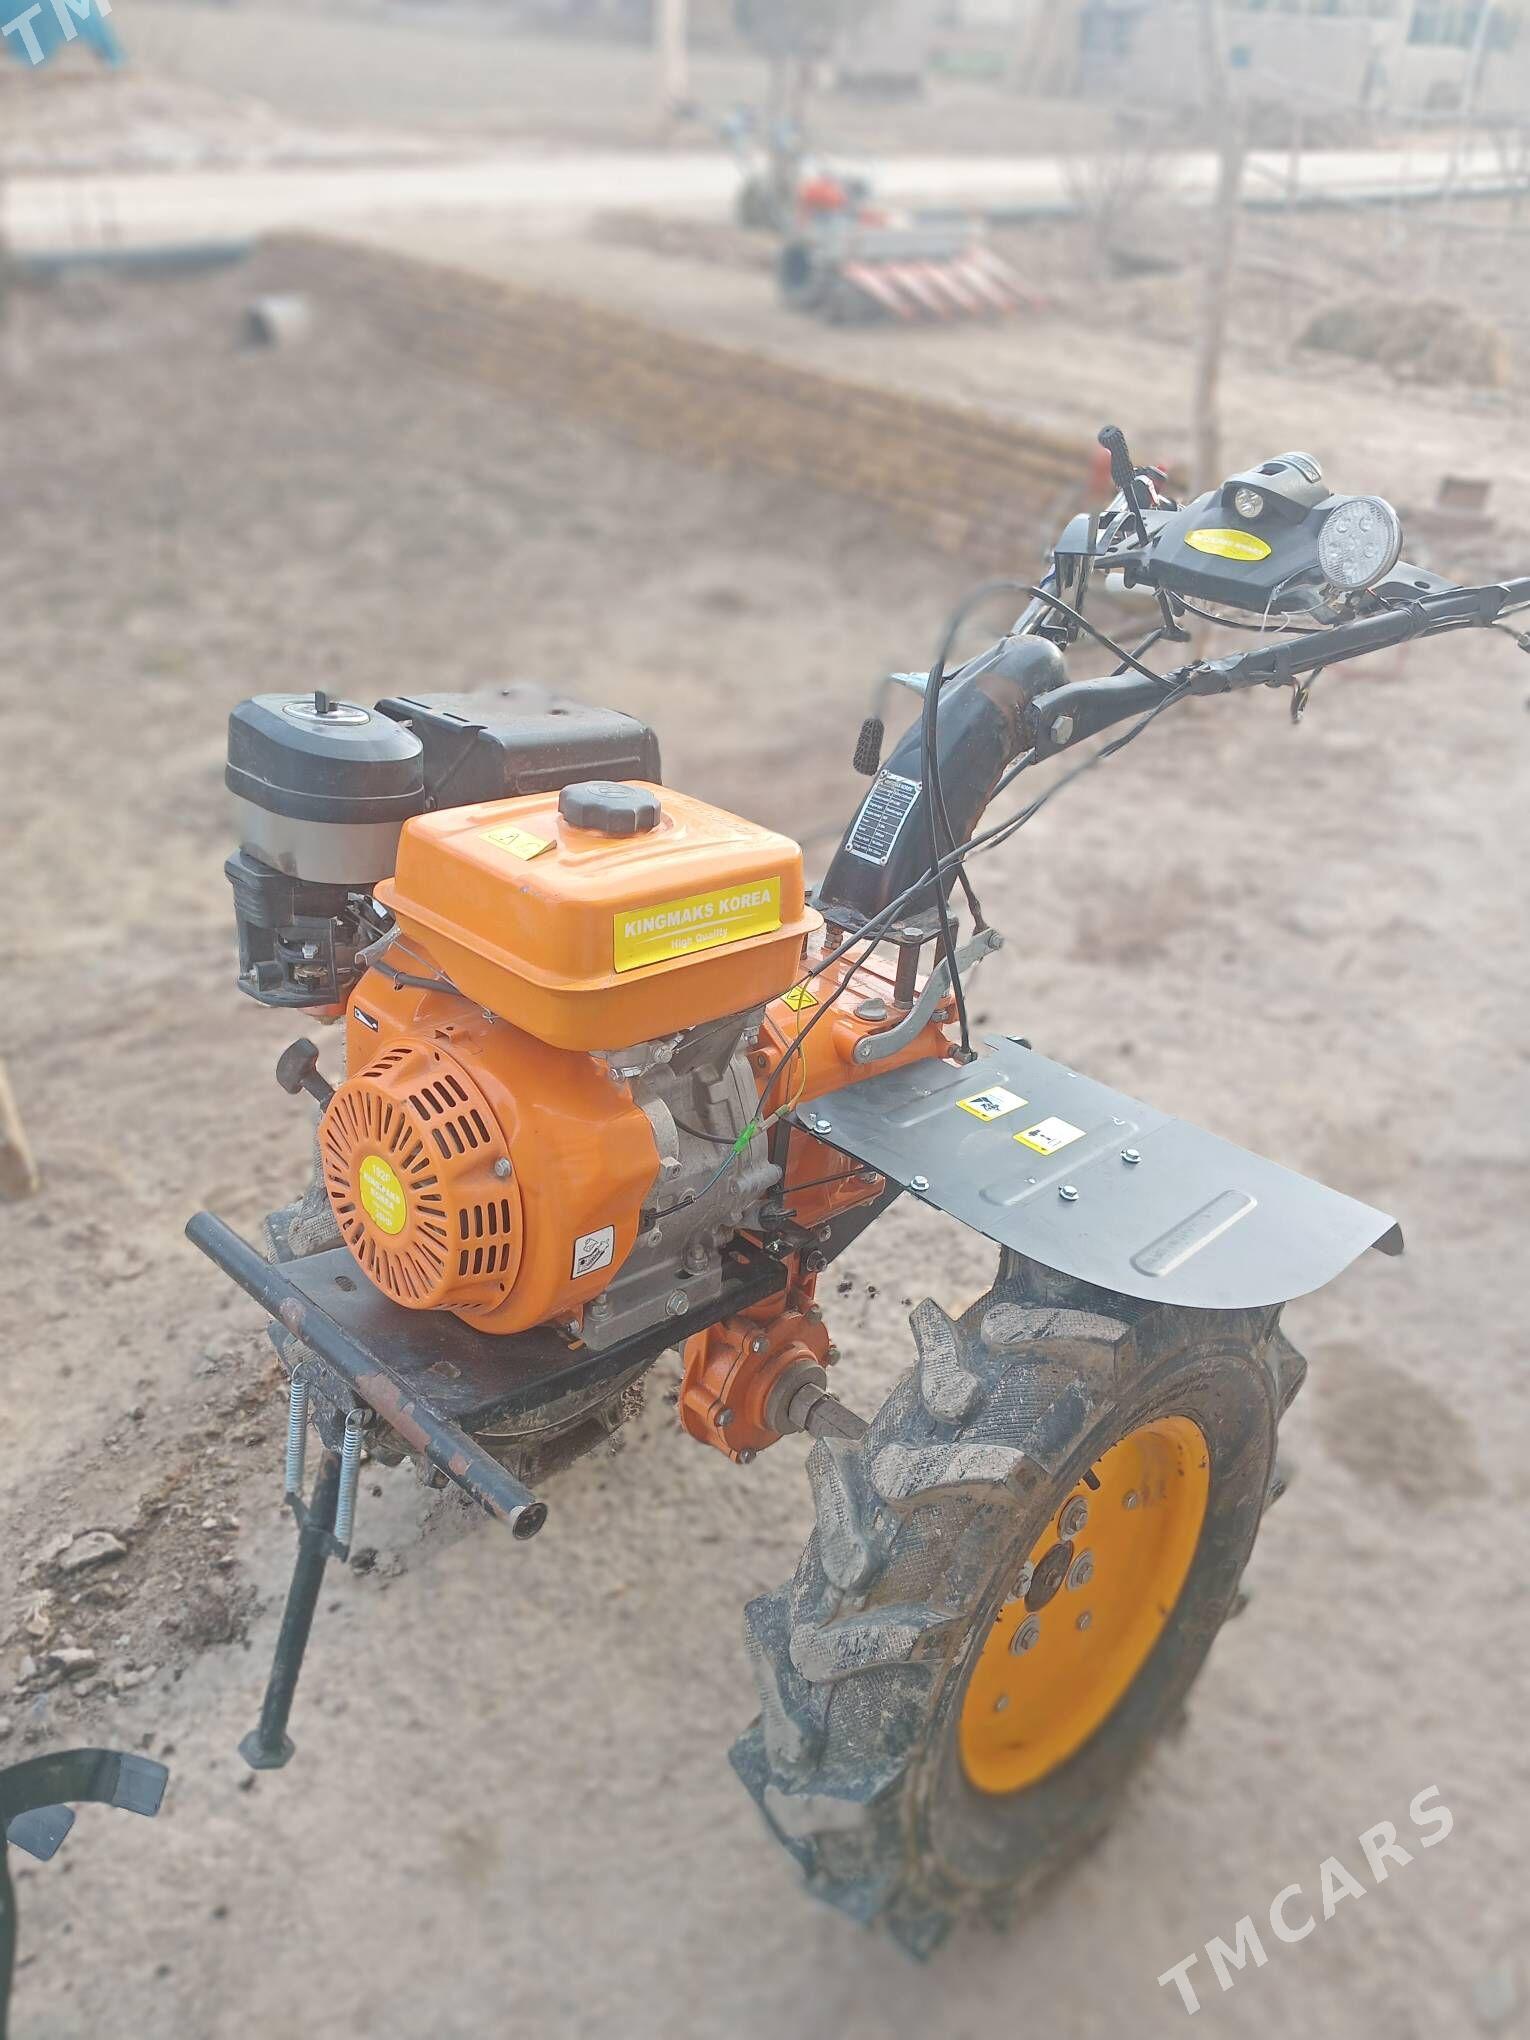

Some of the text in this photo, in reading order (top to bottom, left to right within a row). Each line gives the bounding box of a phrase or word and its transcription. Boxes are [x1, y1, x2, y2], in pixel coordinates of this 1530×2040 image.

[625, 889, 771, 937] KINGMAKS KOREA
[672, 927, 729, 948] High Quality
